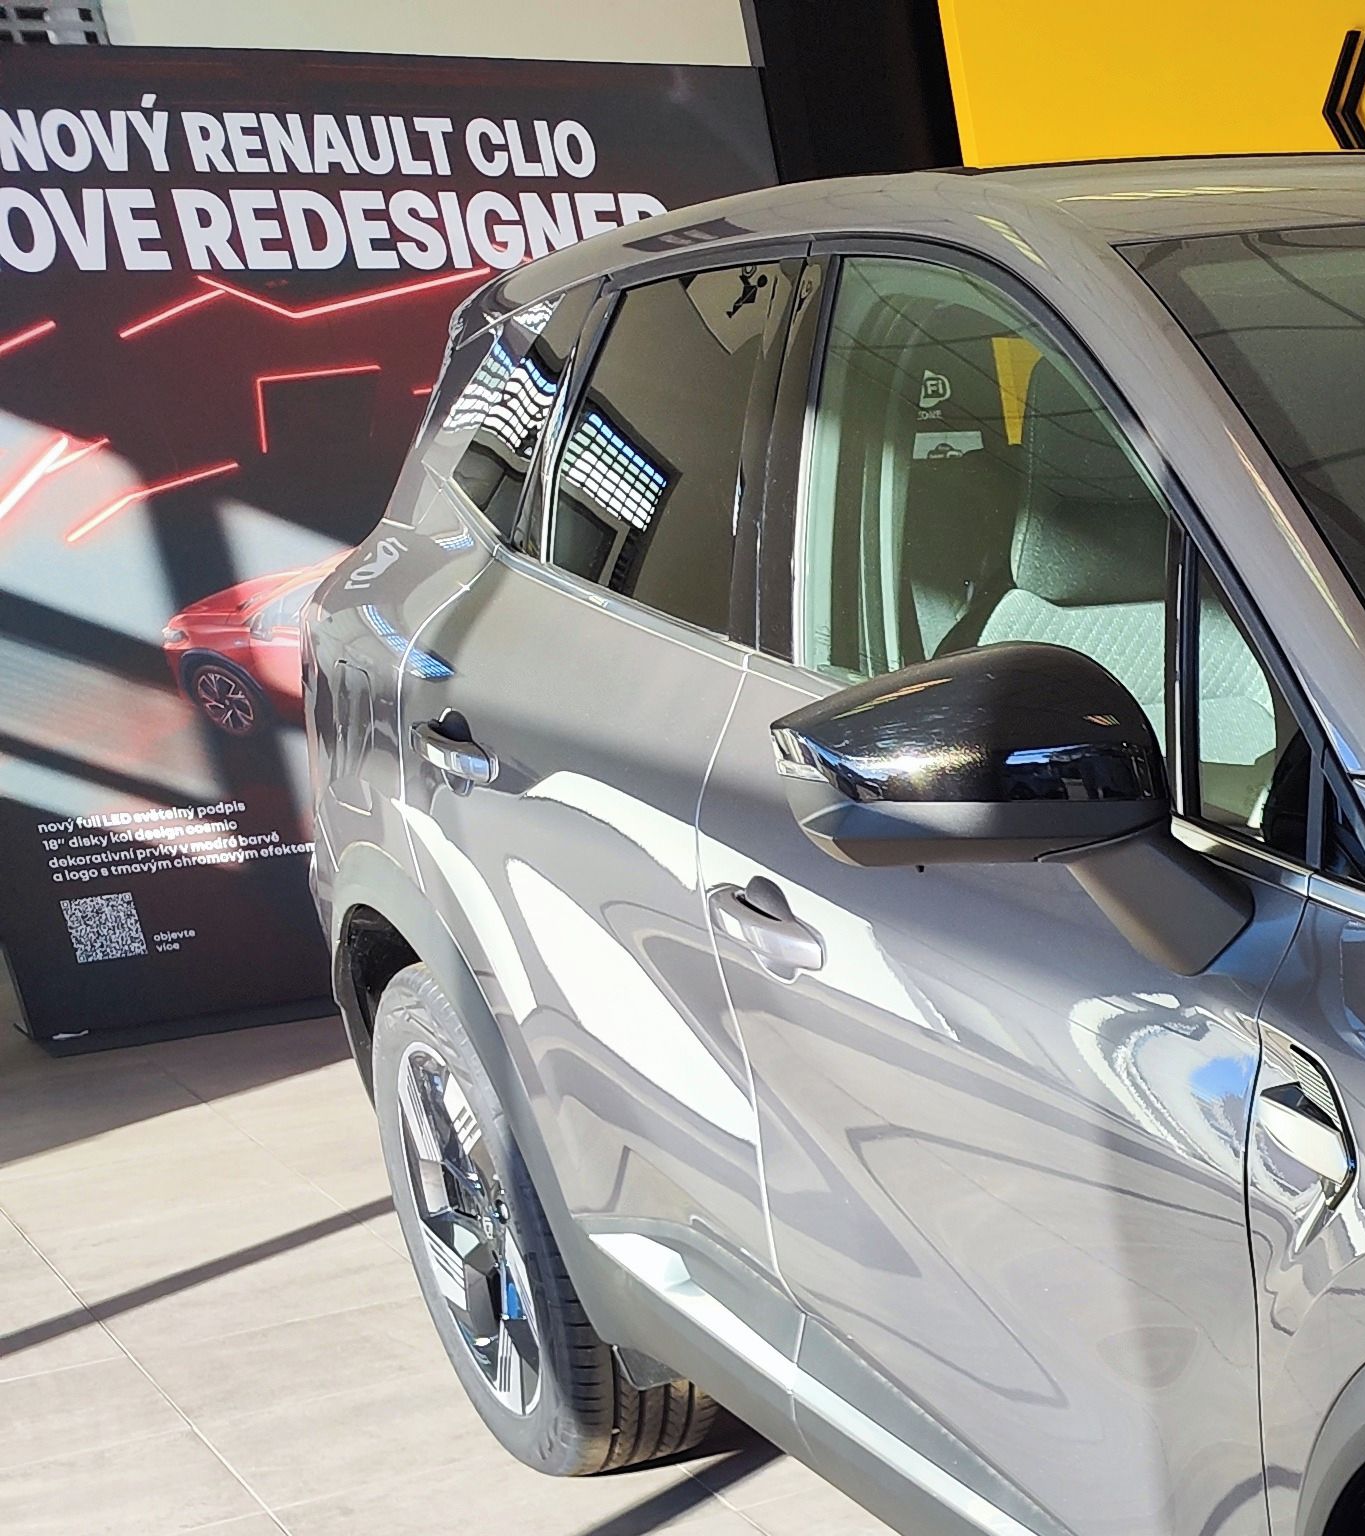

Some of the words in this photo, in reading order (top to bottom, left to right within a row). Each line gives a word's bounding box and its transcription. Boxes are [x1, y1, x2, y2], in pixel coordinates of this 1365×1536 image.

[0, 94, 170, 172] NOVÝ
[180, 111, 452, 177] RENAULT
[466, 116, 596, 178] CLIO
[37, 818, 75, 834] nový
[76, 813, 101, 829] full
[102, 812, 132, 827] LED
[197, 800, 246, 818] podpis
[48, 849, 135, 869] dekorativní
[136, 843, 177, 860] prvky
[179, 843, 189, 854] v
[238, 831, 280, 847] barvě
[68, 834, 108, 848] disky
[109, 830, 133, 844] kol
[134, 826, 185, 841] design
[52, 872, 64, 882] a
[64, 869, 99, 882] logo
[100, 867, 109, 877] s
[110, 858, 172, 875] tmavým
[173, 848, 259, 868] chromovým
[153, 929, 196, 942] objevte
[155, 942, 180, 952] více
